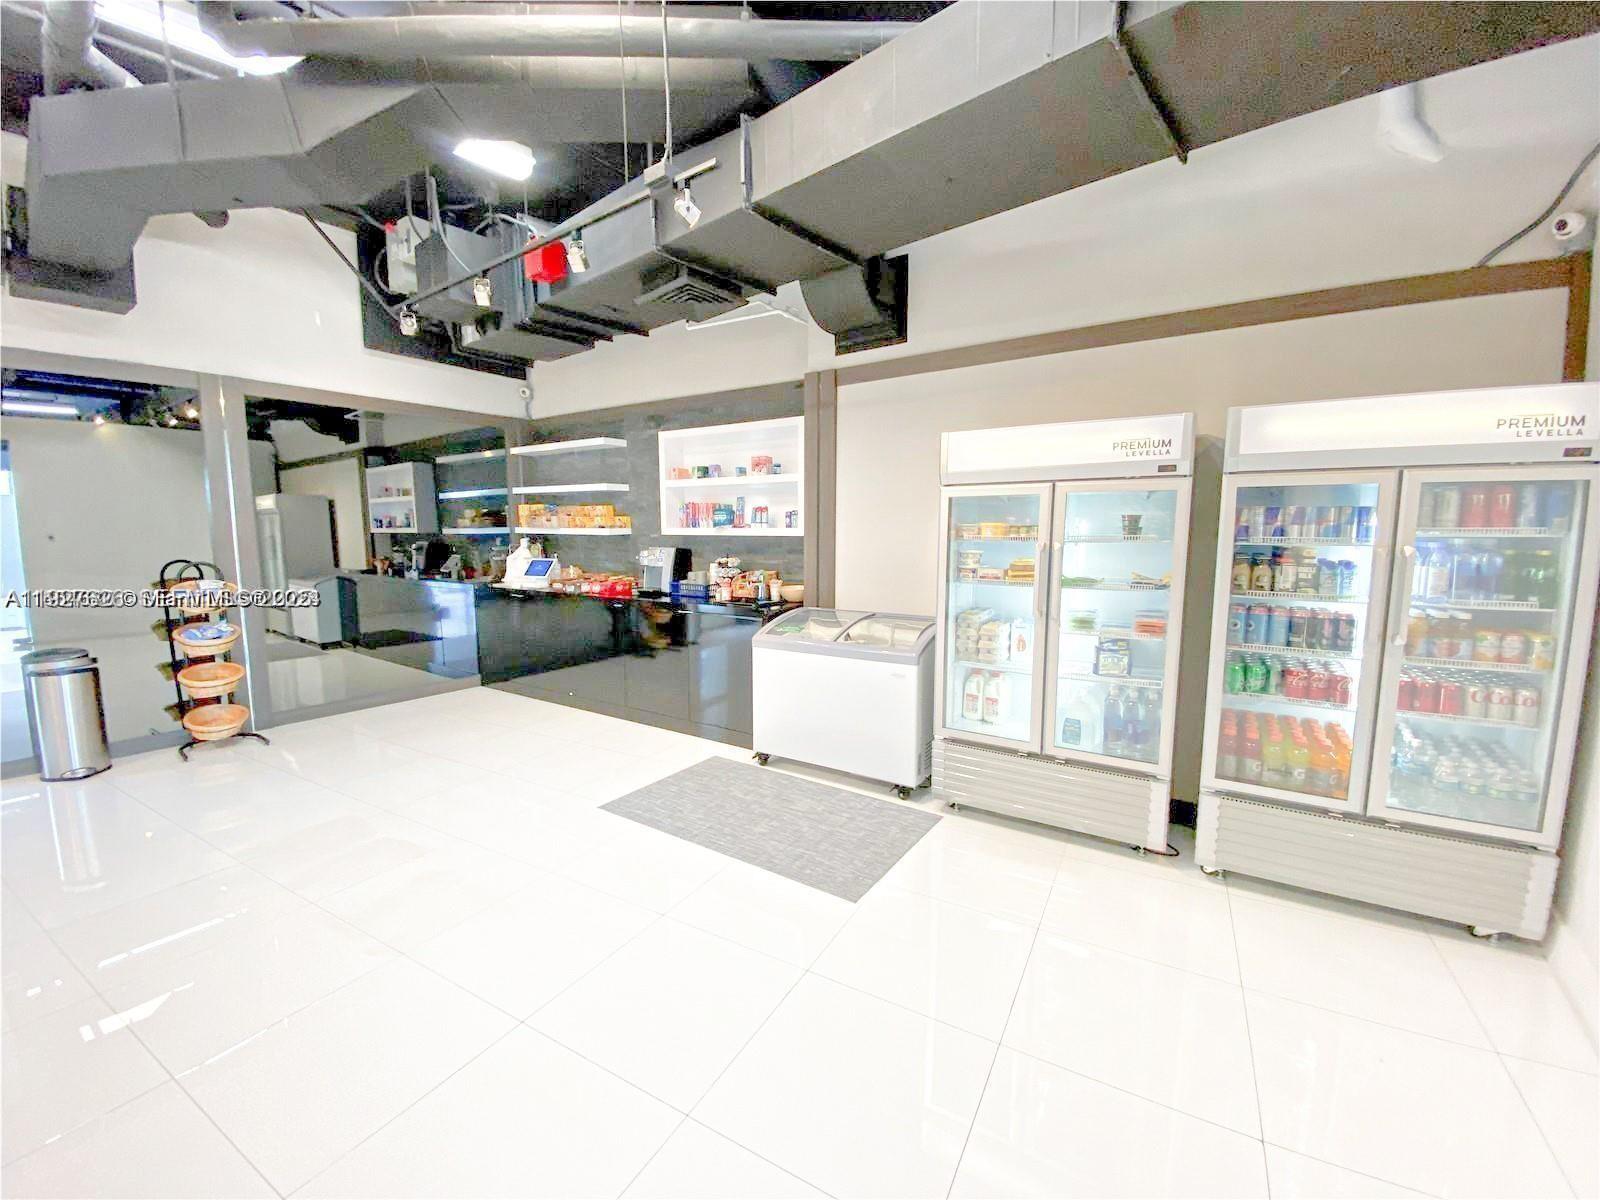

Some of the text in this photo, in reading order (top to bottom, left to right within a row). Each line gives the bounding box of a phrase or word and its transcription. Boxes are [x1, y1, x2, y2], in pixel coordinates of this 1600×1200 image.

[1496, 413, 1586, 429] PREMIUM
[1516, 429, 1584, 437] LEVELLA
[1112, 437, 1172, 451] PREMIUM
[1125, 449, 1171, 457] LEVELLA
